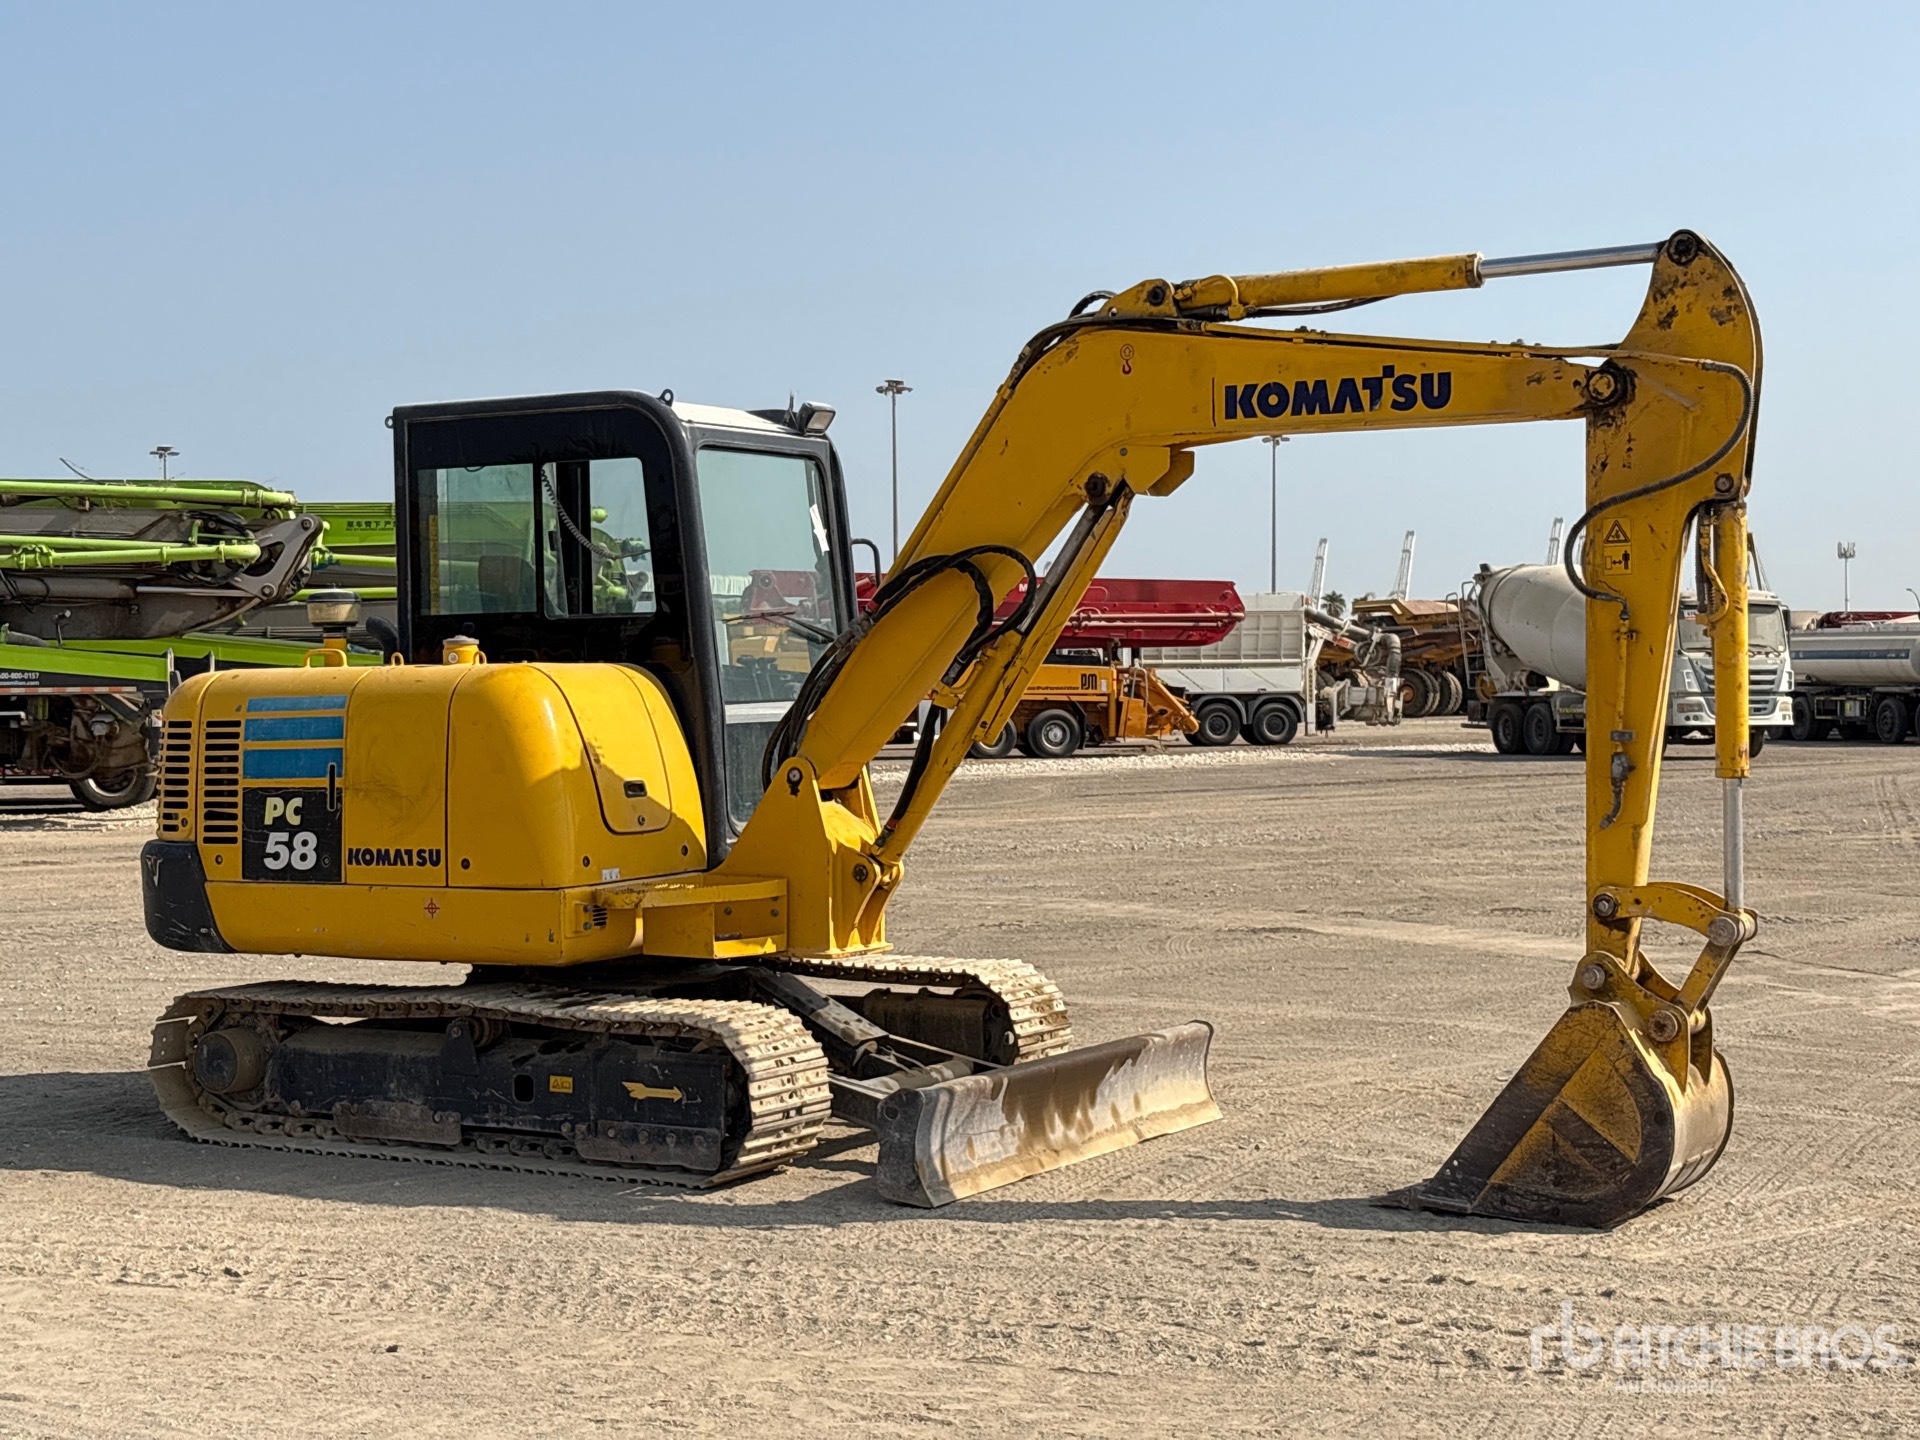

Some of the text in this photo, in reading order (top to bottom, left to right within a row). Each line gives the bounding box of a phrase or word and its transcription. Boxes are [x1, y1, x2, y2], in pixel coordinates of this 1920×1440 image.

[1224, 365, 1452, 420] KOMATSU
[264, 797, 303, 826] PC
[263, 831, 318, 871] 58
[347, 847, 442, 868] KOMATSU
